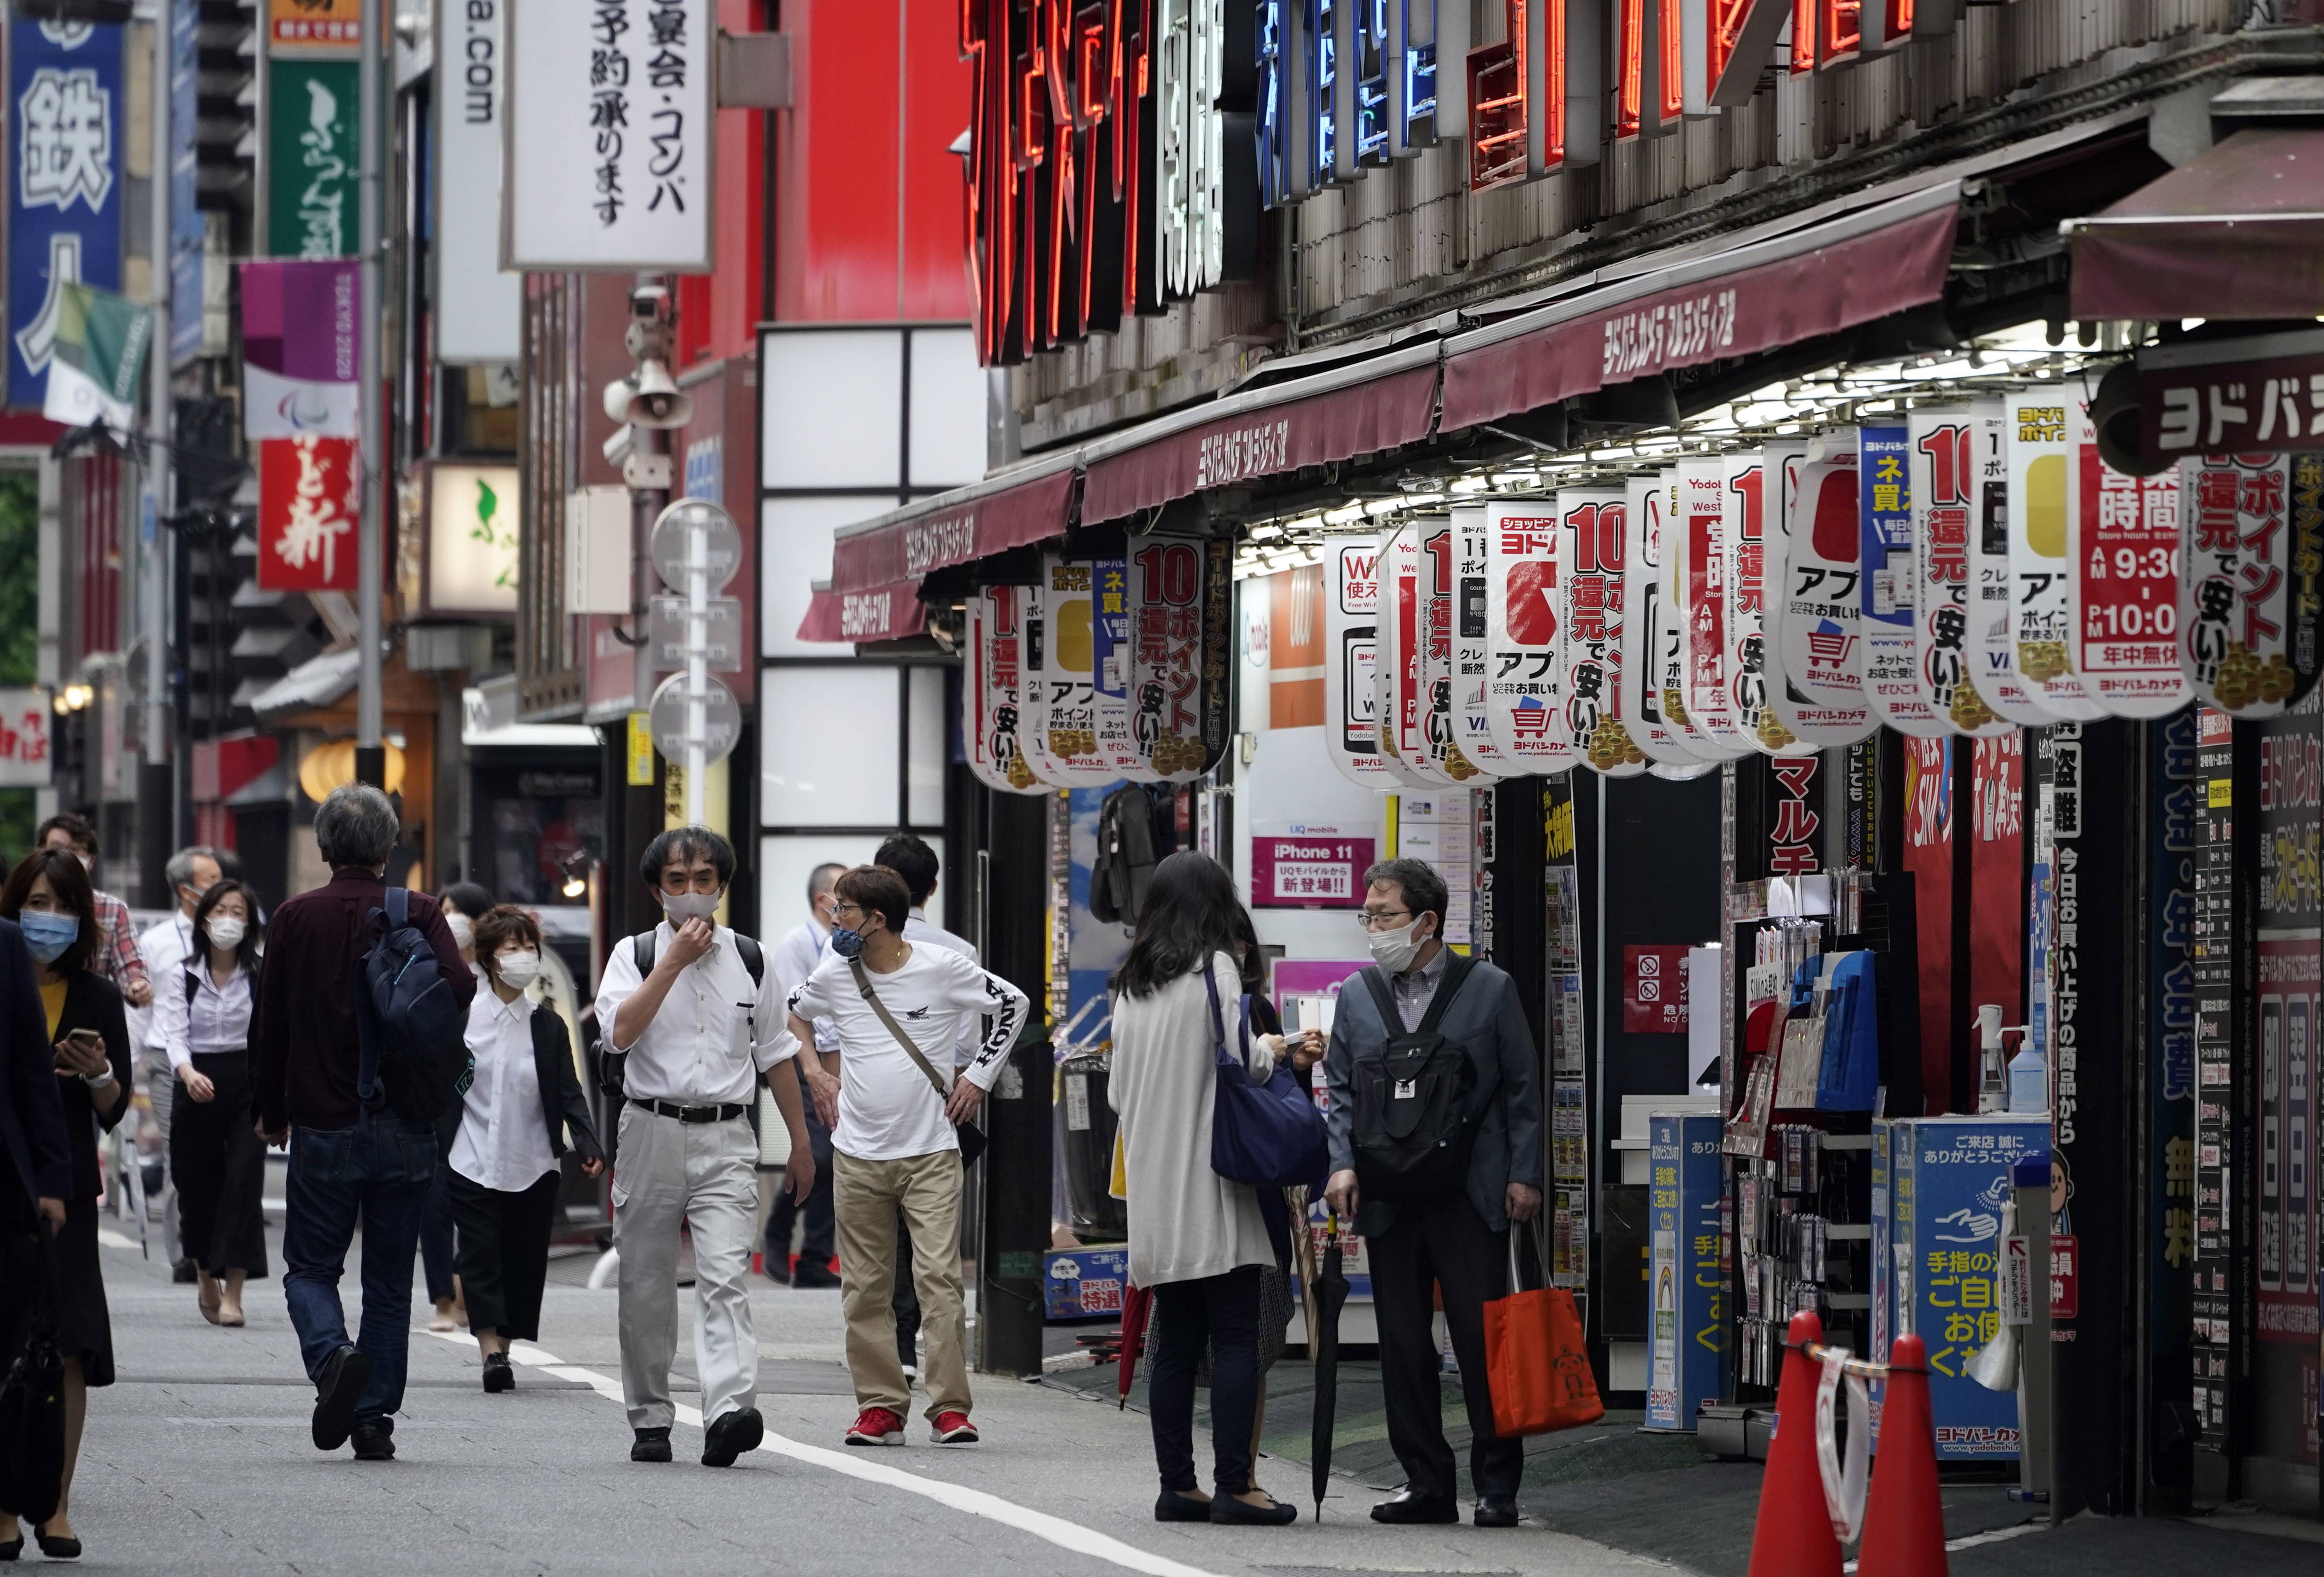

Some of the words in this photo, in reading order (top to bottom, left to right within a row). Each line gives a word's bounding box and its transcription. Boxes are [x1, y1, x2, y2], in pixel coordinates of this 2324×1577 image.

[590, 0, 629, 226] 予約承ります
[647, 0, 687, 213] 宴会・コンパ
[1503, 518, 1556, 530] ショッピン
[2123, 532, 2149, 541] hours
[2241, 472, 2285, 651] ポイント
[1136, 544, 1199, 606] 10
[1496, 651, 1555, 679] アプ
[2099, 679, 2182, 691] ヨドバシカメラ
[1797, 710, 1867, 720] ヨドバシカメラ
[1290, 825, 1306, 834] UQ
[1307, 826, 1338, 834] mobile
[1274, 844, 1331, 859] iPhone
[1336, 845, 1352, 859] 11
[1279, 867, 1347, 876] UQモバイルから
[1283, 877, 1344, 893] 新登場!!
[2059, 848, 2078, 1145] 今日お買い上げの商品から
[1956, 1135, 1995, 1149] ご来店
[1998, 1135, 2024, 1149] 誠に
[1928, 1251, 1999, 1273] 手指の
[1929, 1275, 1999, 1308] ご自
[2018, 1259, 2029, 1318] 折りたたみ傘には
[1082, 1290, 1121, 1310] 特選
